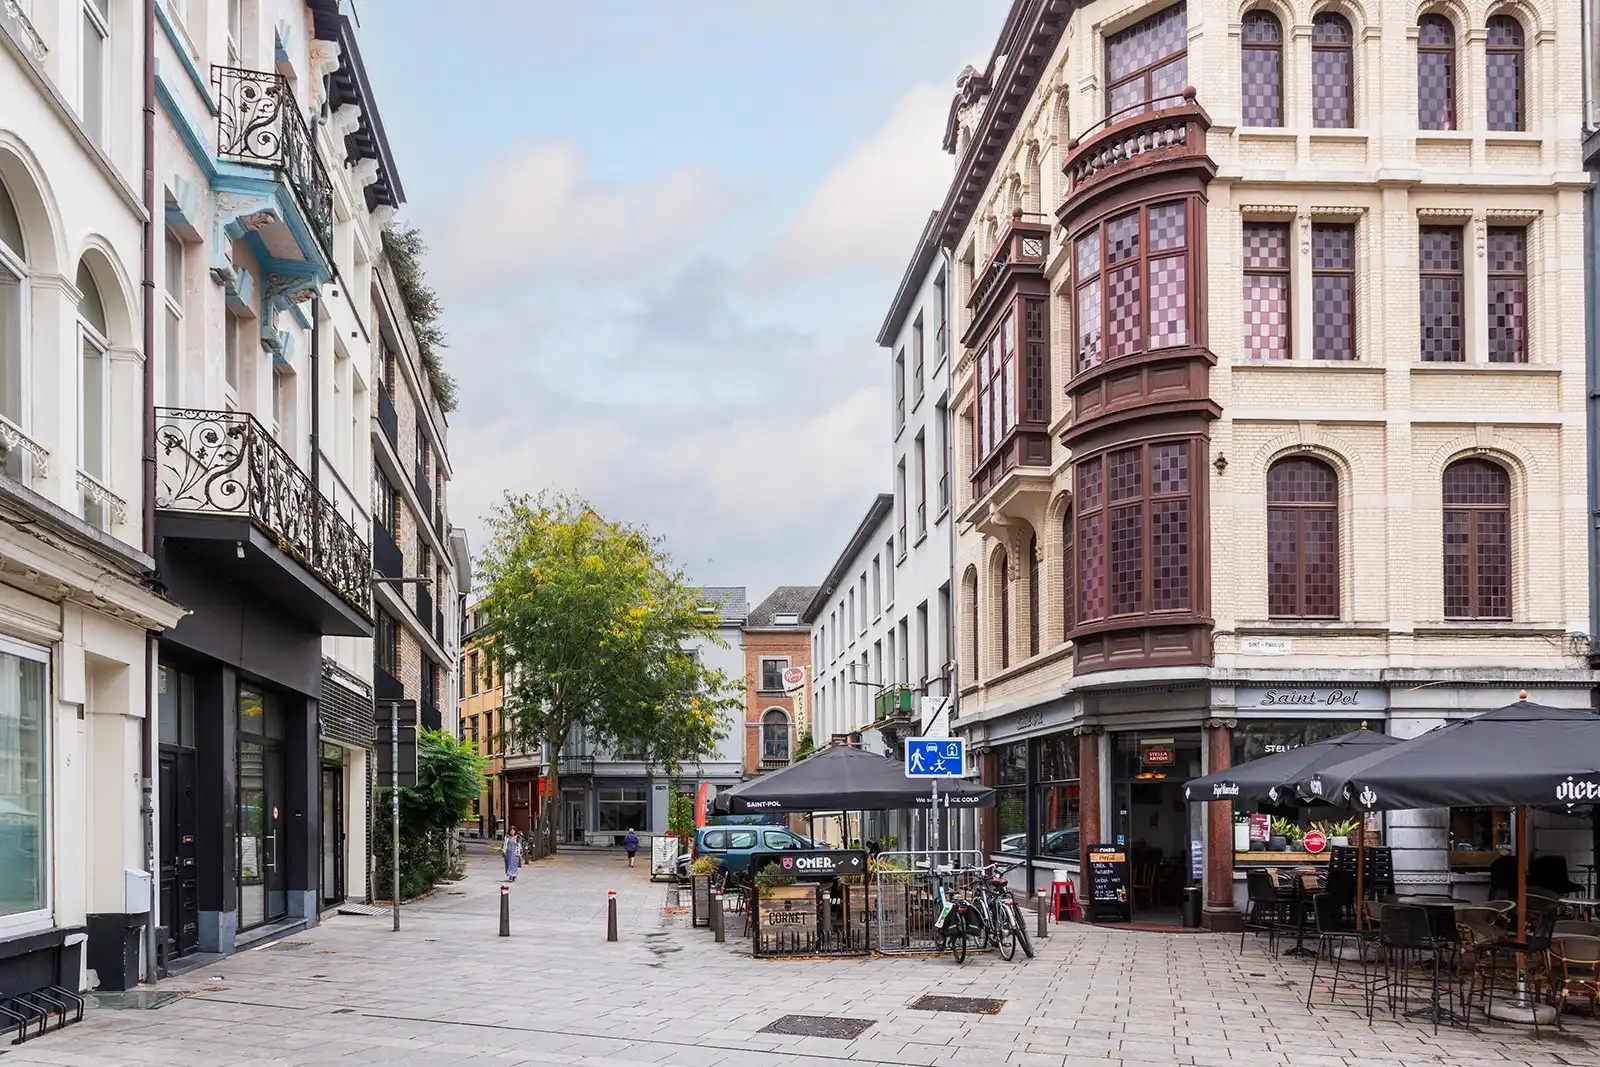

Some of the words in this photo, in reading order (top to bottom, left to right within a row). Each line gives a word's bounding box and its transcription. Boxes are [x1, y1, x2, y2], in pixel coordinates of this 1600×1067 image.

[1260, 689, 1360, 706] Saint-Pol
[1556, 775, 1600, 800] vict
[746, 800, 781, 808] SAINT-POL
[769, 912, 808, 926] CORNET
